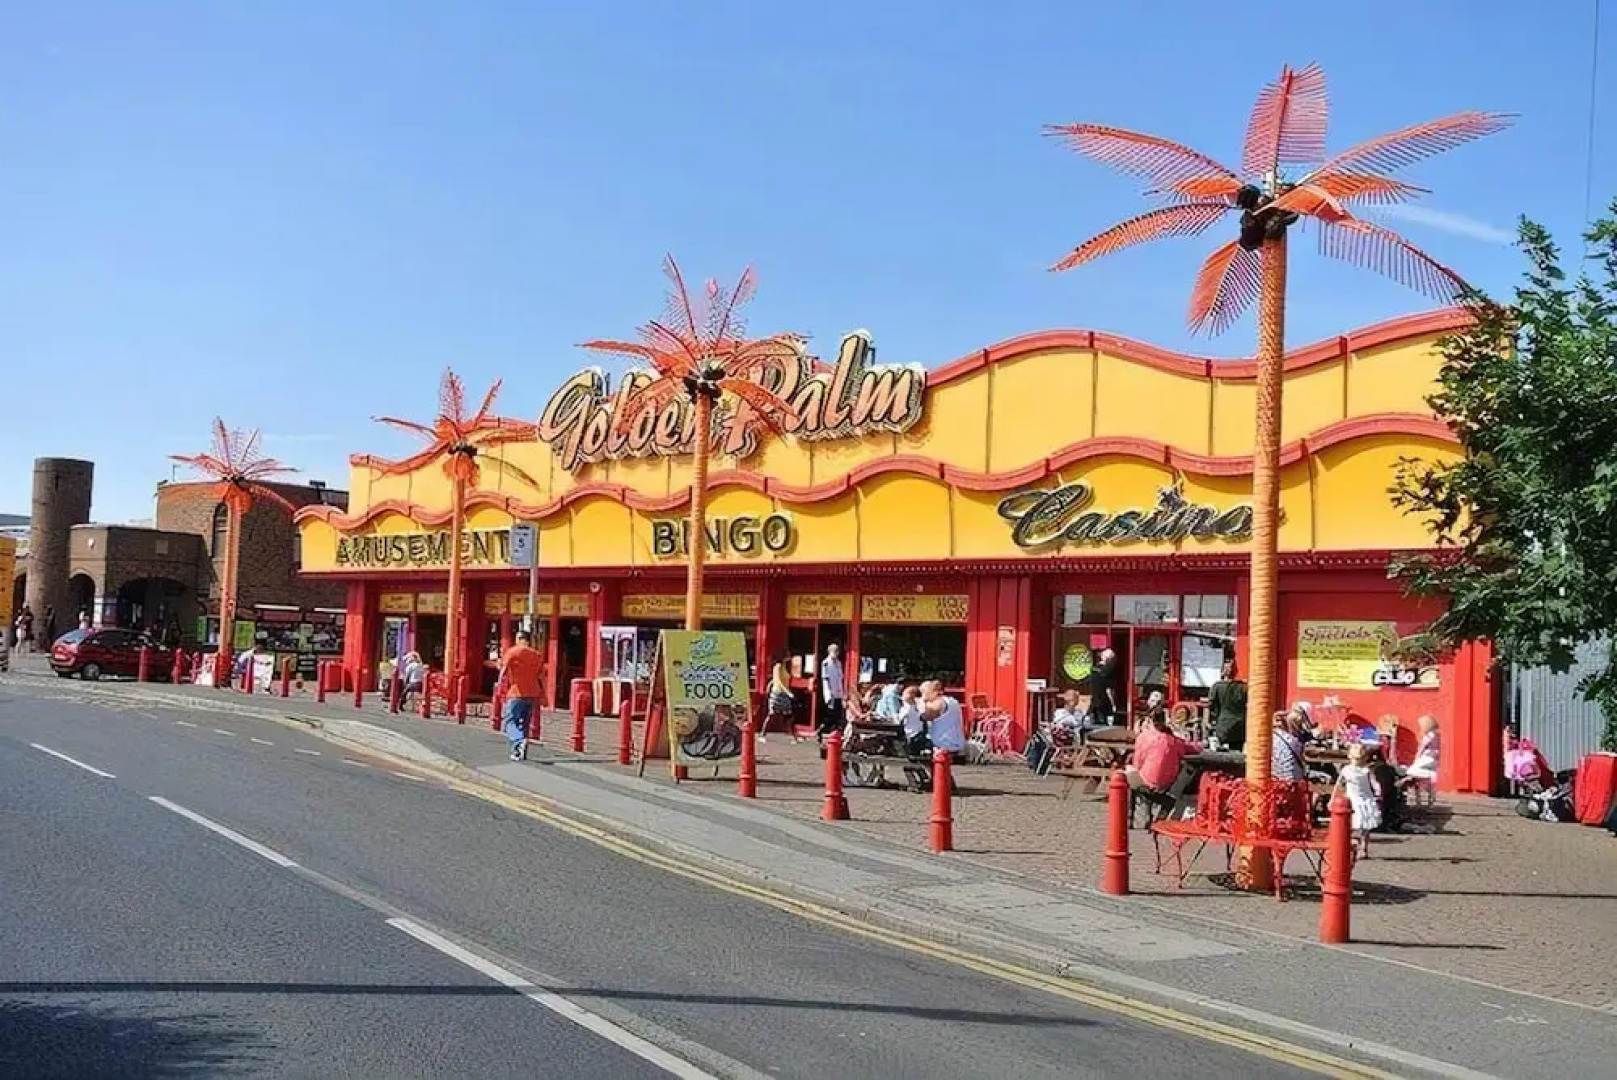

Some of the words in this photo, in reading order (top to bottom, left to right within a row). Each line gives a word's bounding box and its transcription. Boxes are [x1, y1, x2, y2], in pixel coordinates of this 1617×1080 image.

[652, 514, 795, 556] BINGO
[997, 484, 1253, 548] Casino
[683, 683, 734, 699] FOOD
